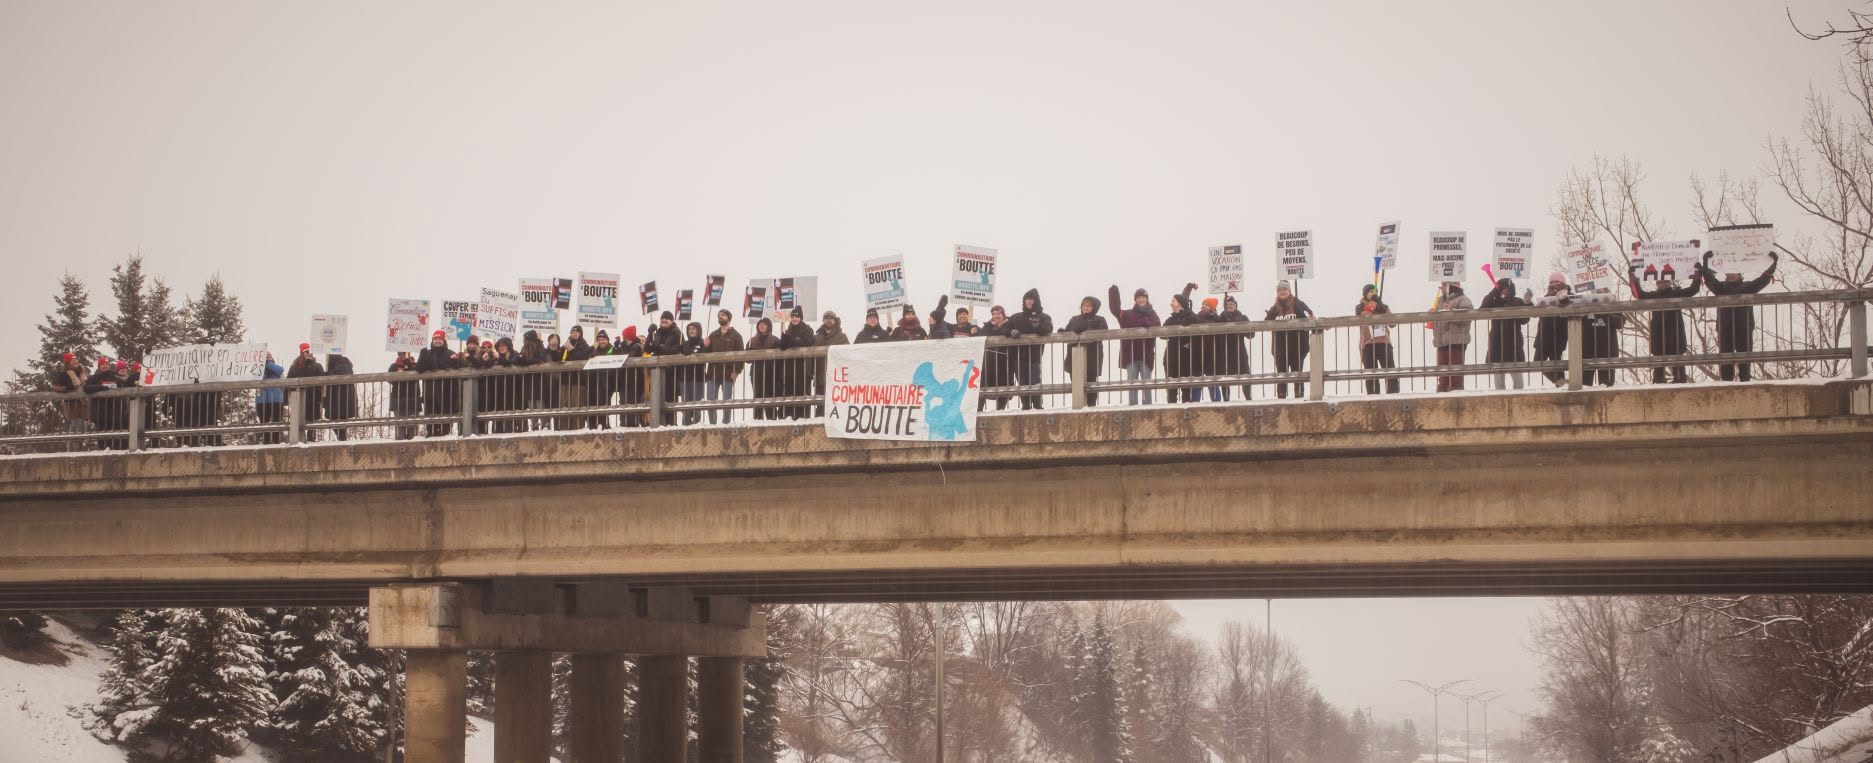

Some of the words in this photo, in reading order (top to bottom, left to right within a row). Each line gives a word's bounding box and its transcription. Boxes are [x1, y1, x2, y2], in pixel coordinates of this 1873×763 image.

[1280, 231, 1308, 240] BEAUCOUP
[482, 287, 519, 301] Saguenay
[443, 301, 469, 312] COUPER
[481, 303, 519, 319] SUFFISANT
[479, 319, 517, 333] MISSION
[142, 348, 214, 369] Communautaire
[217, 349, 230, 360] en
[833, 366, 849, 383] LE
[832, 383, 925, 405] COMMUNAUTAIRE
[845, 405, 921, 436] BOUTTE
